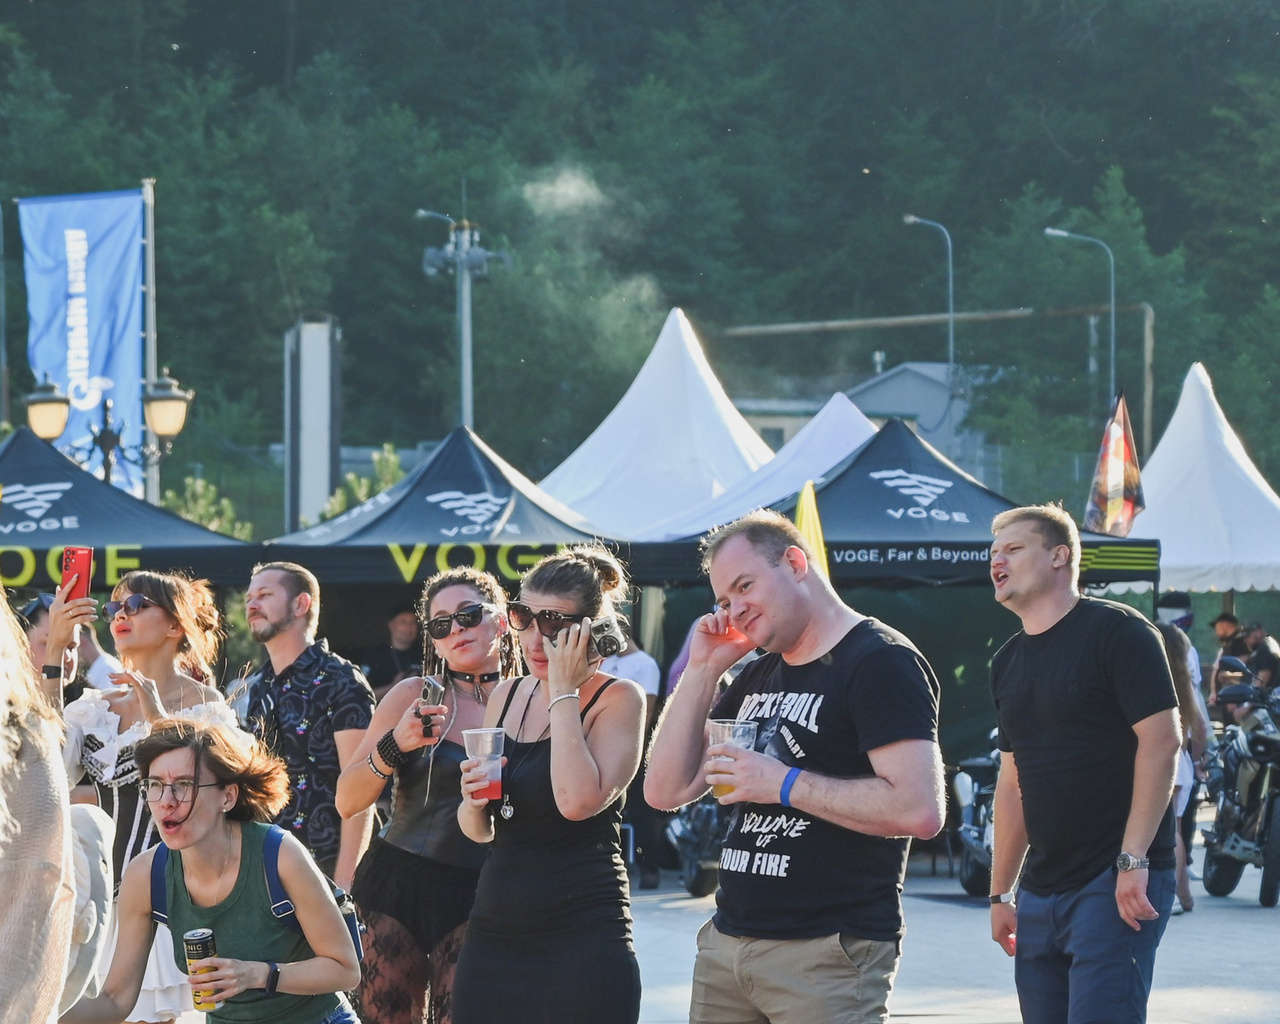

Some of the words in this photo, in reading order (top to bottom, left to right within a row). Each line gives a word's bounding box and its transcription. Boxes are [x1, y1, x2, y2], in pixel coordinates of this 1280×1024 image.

[886, 507, 970, 523] VOGE
[387, 543, 566, 583] VOG
[833, 548, 884, 564] VOGE,
[888, 548, 915, 561] Far
[916, 547, 927, 561] &
[931, 546, 989, 563] Beyond
[740, 811, 811, 838] VOLUME
[751, 852, 791, 877] FIRE
